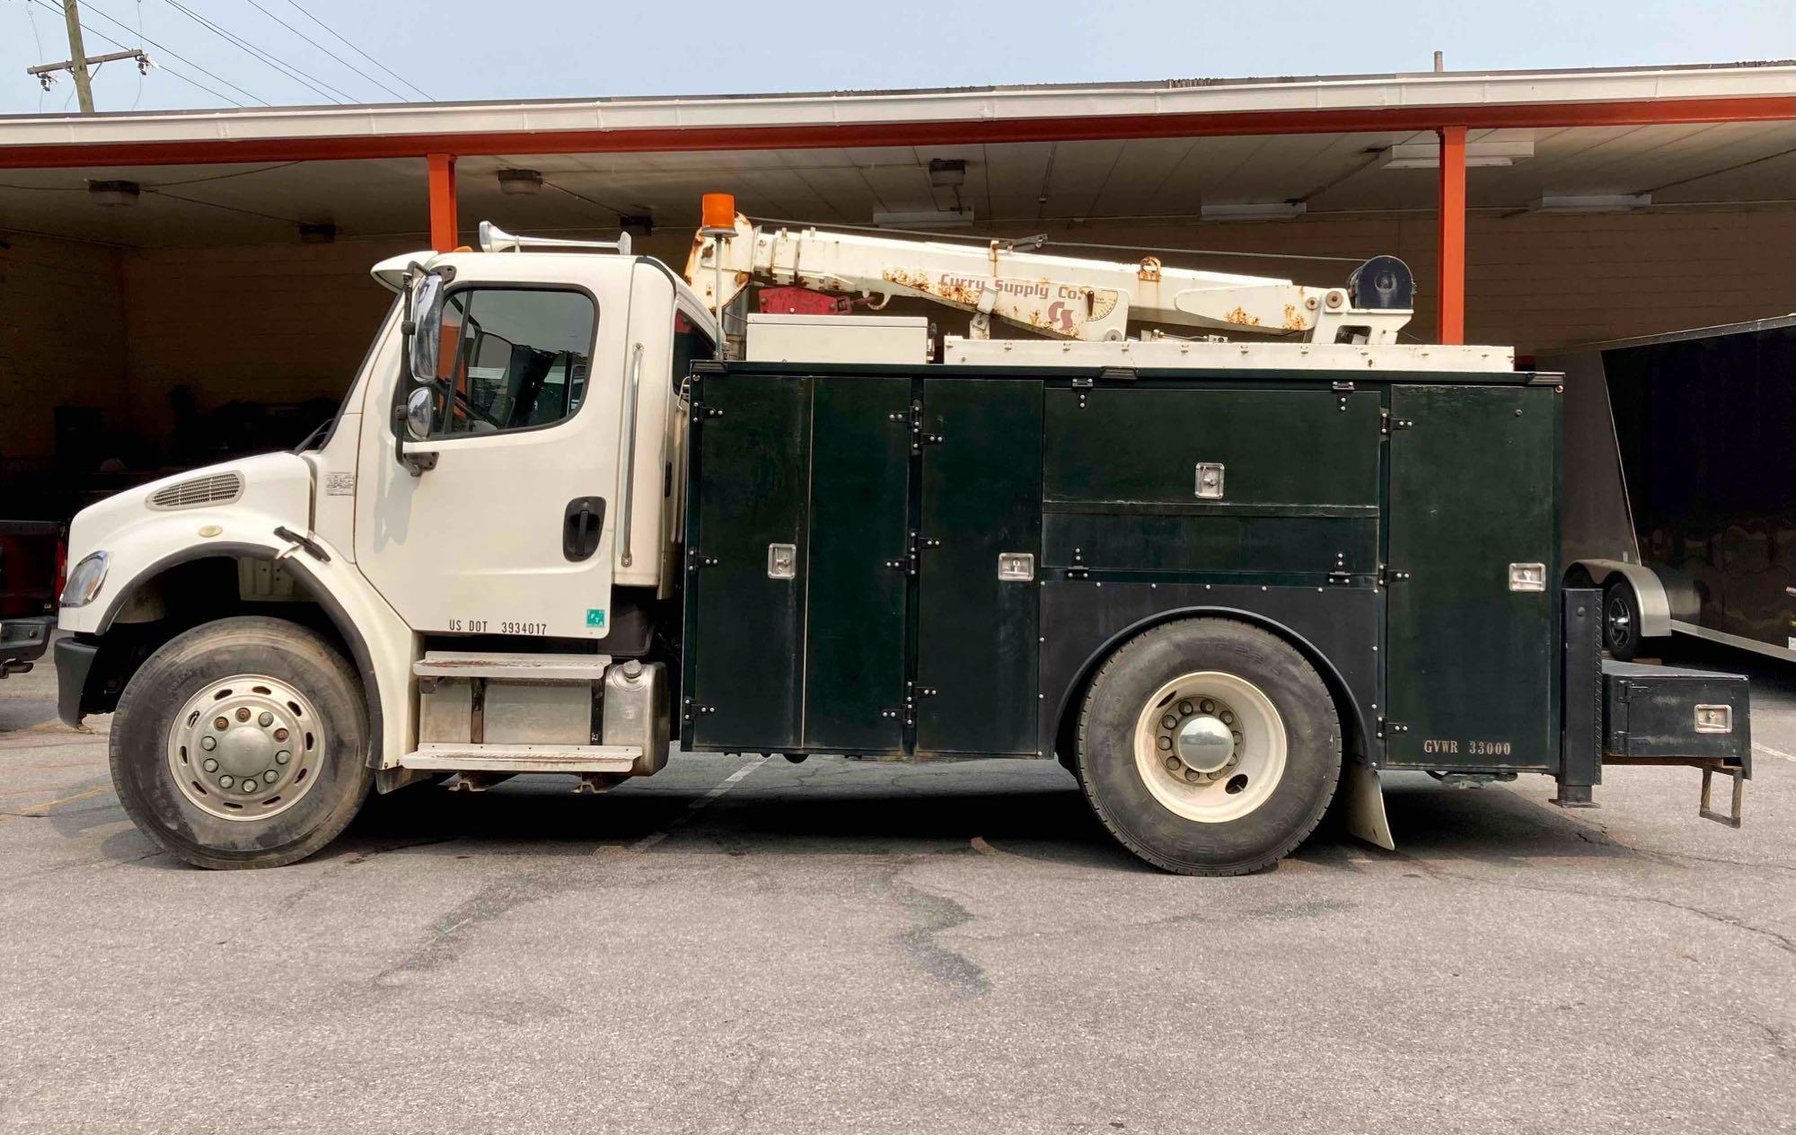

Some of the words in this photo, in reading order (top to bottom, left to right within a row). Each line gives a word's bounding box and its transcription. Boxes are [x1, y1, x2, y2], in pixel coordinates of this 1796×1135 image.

[940, 273, 986, 293] Curry
[994, 279, 1049, 300] Supply
[1058, 285, 1083, 301] Co.
[449, 619, 462, 631] US
[468, 620, 488, 632] DOT
[501, 621, 548, 635] 3934017
[1423, 739, 1458, 753] GVWR
[1468, 740, 1511, 755] 33000
